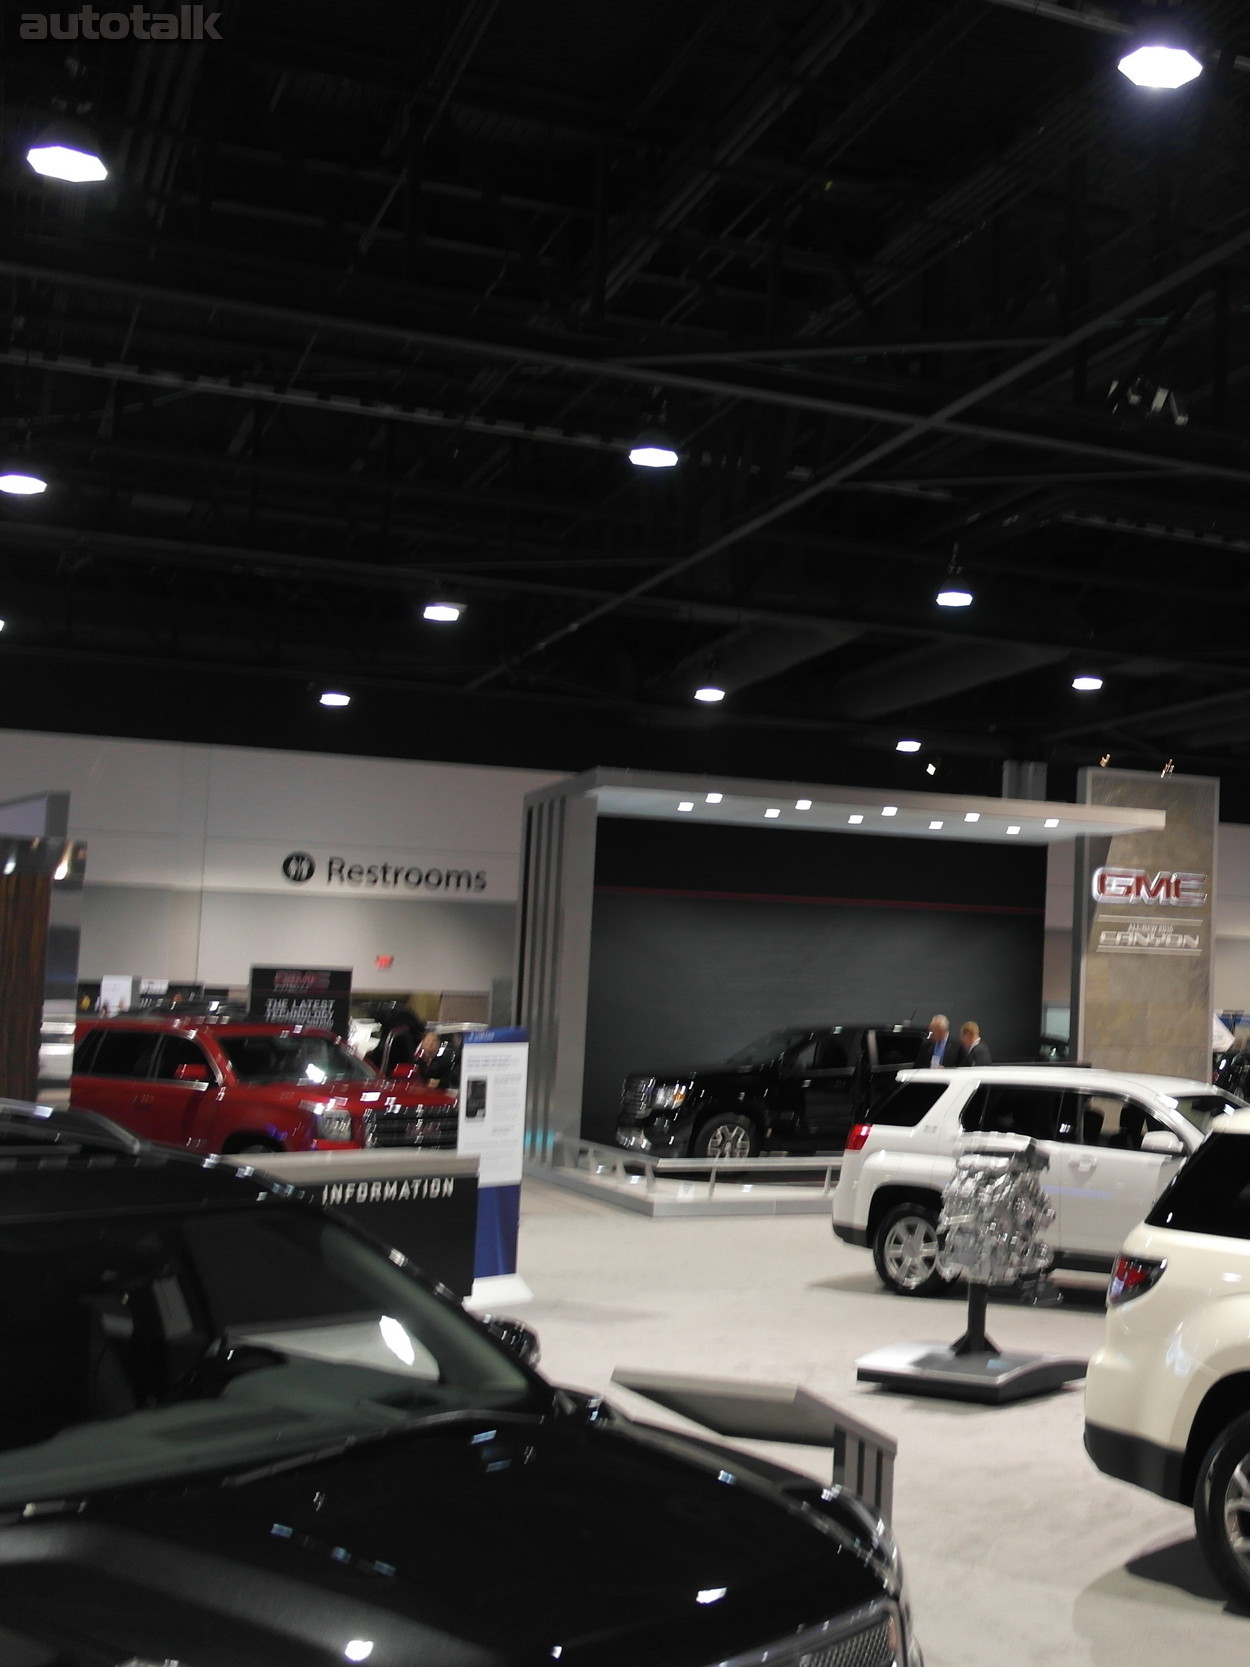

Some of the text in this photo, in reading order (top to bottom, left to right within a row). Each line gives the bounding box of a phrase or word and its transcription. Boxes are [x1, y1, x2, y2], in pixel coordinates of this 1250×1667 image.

[327, 856, 487, 893] Restrooms
[1092, 867, 1208, 907] GMC
[1100, 930, 1200, 949] CANYON
[265, 998, 335, 1011] THE LATEST
[322, 1177, 454, 1206] INFORMATION
